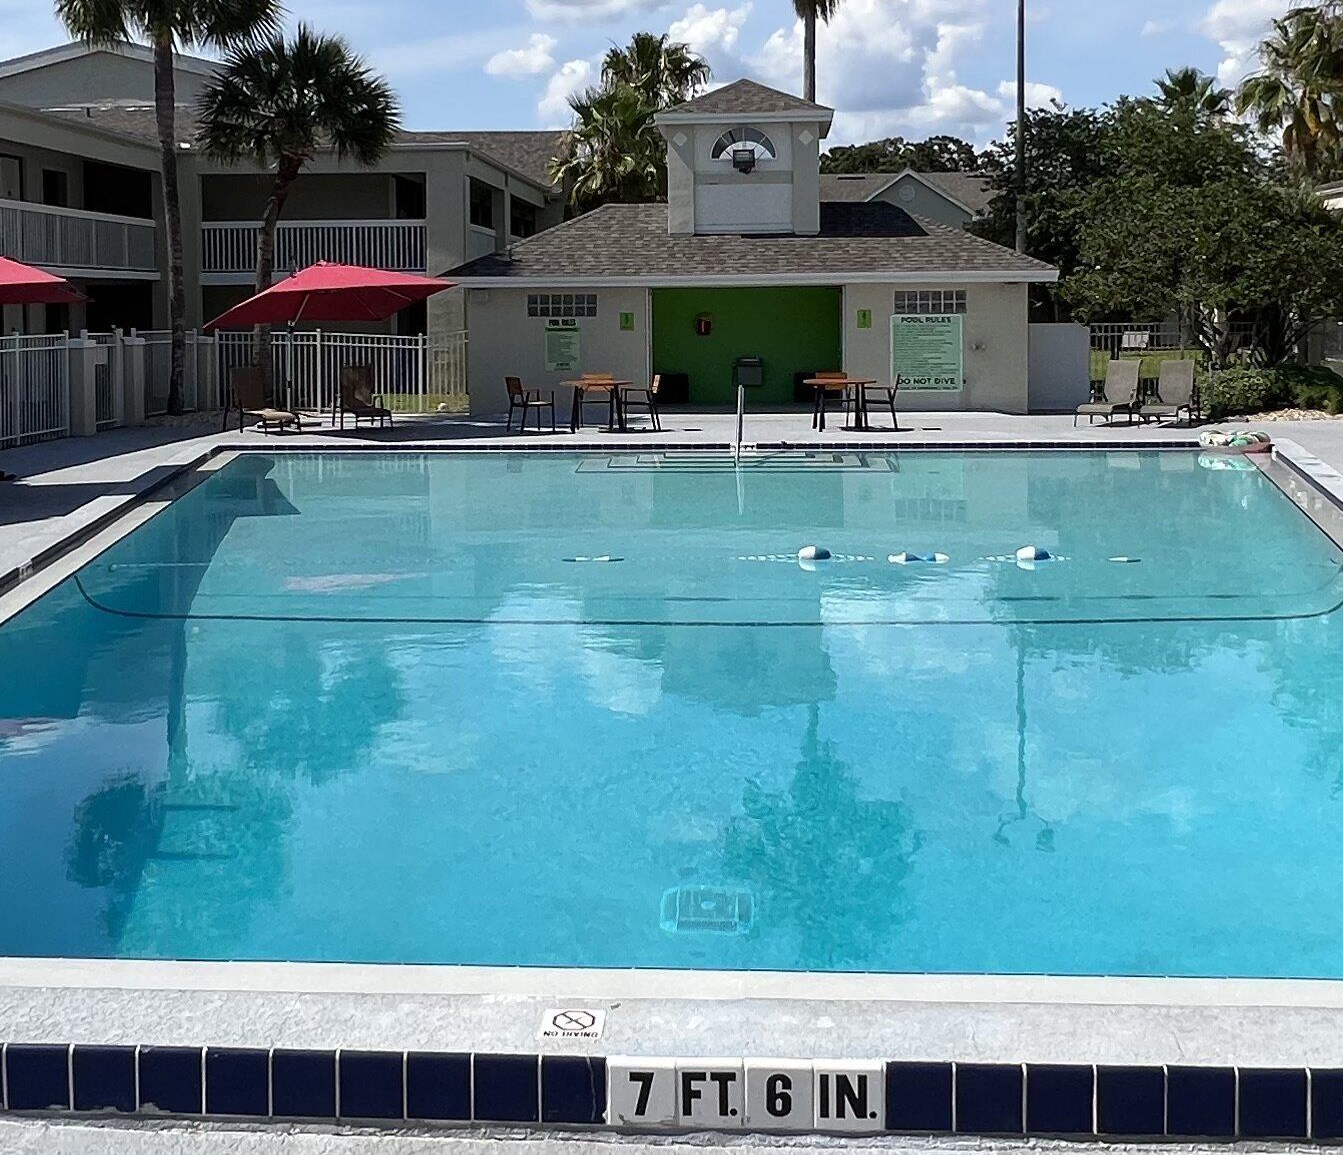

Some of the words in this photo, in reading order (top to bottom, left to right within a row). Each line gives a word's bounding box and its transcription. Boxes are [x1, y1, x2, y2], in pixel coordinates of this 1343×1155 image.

[898, 377, 911, 385] DO
[913, 377, 931, 385] NOT
[934, 377, 956, 385] DIVE
[628, 1072, 655, 1116] 7
[681, 1072, 738, 1117] FT.
[765, 1073, 793, 1118] 6
[819, 1074, 878, 1120] IN.
